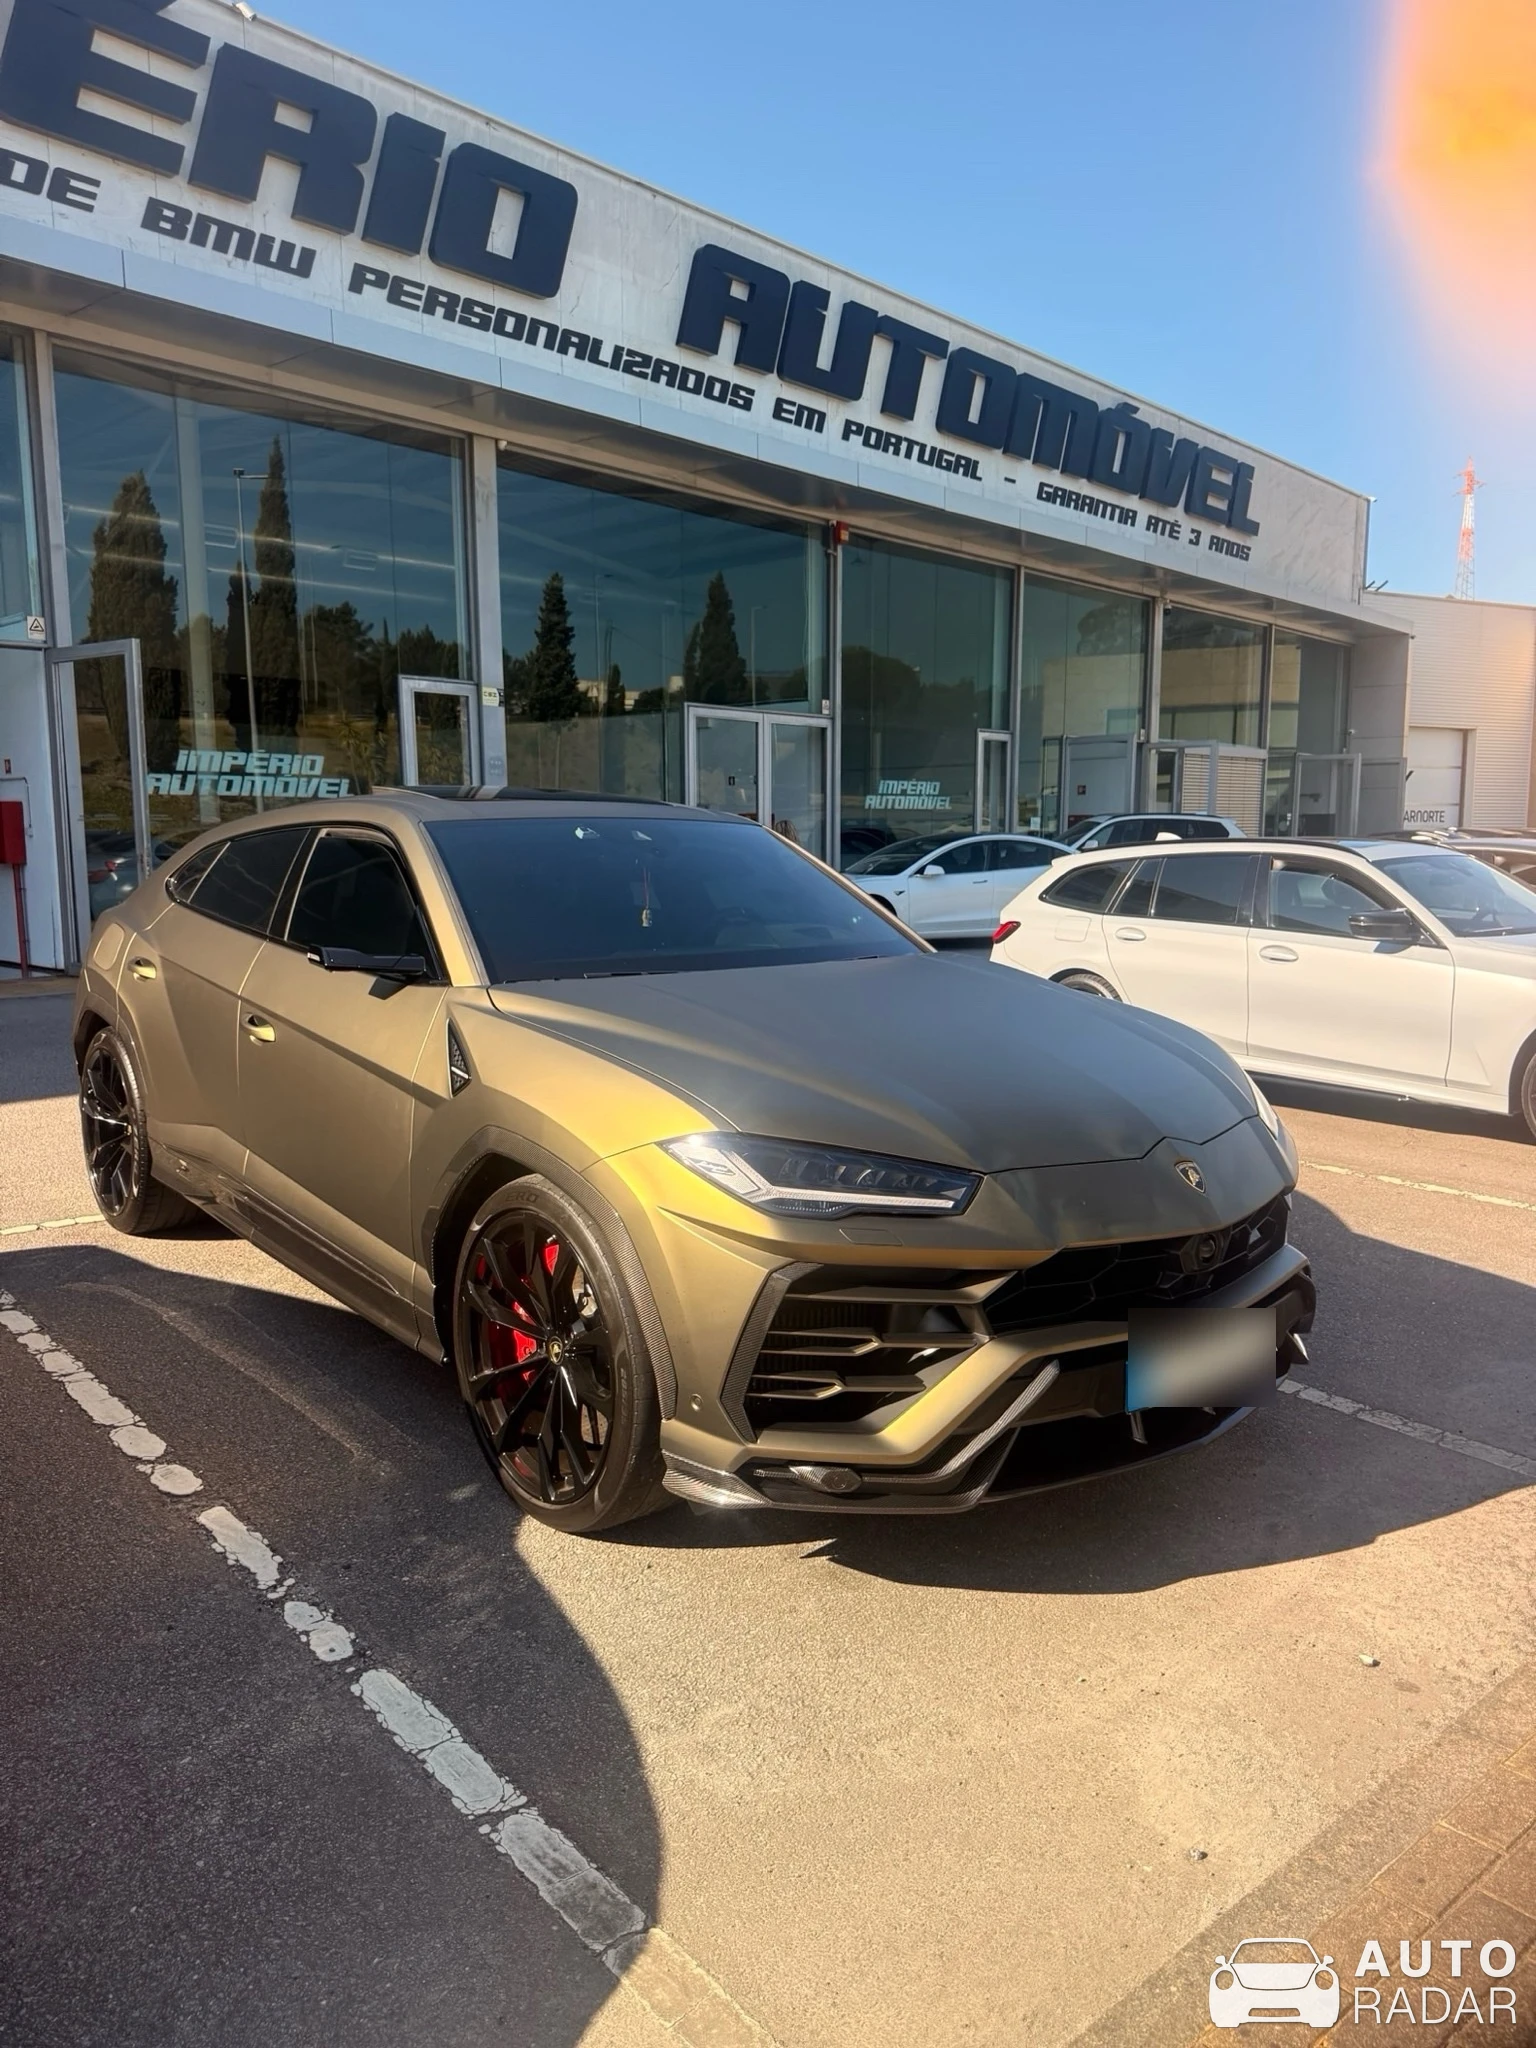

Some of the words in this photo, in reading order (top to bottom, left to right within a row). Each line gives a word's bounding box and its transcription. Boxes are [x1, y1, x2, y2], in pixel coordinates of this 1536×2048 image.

[0, 147, 101, 212] DE
[140, 196, 317, 279] BMW
[347, 262, 756, 412] PERSONALIZADOS
[772, 397, 827, 434] EM
[841, 418, 983, 482] PORTUGAL
[1036, 481, 1138, 528] GARANTIA
[1145, 514, 1183, 541] ATÉ
[1188, 528, 1202, 547] 3
[1208, 535, 1252, 562] ANOS
[676, 243, 1260, 537] AUTOMÓVEL
[176, 749, 325, 776] IMPÉRIO
[148, 772, 355, 799] AUTOMÓVEL
[878, 778, 941, 795] IMPÉRIO
[864, 794, 953, 810] AUTOMÓVEL
